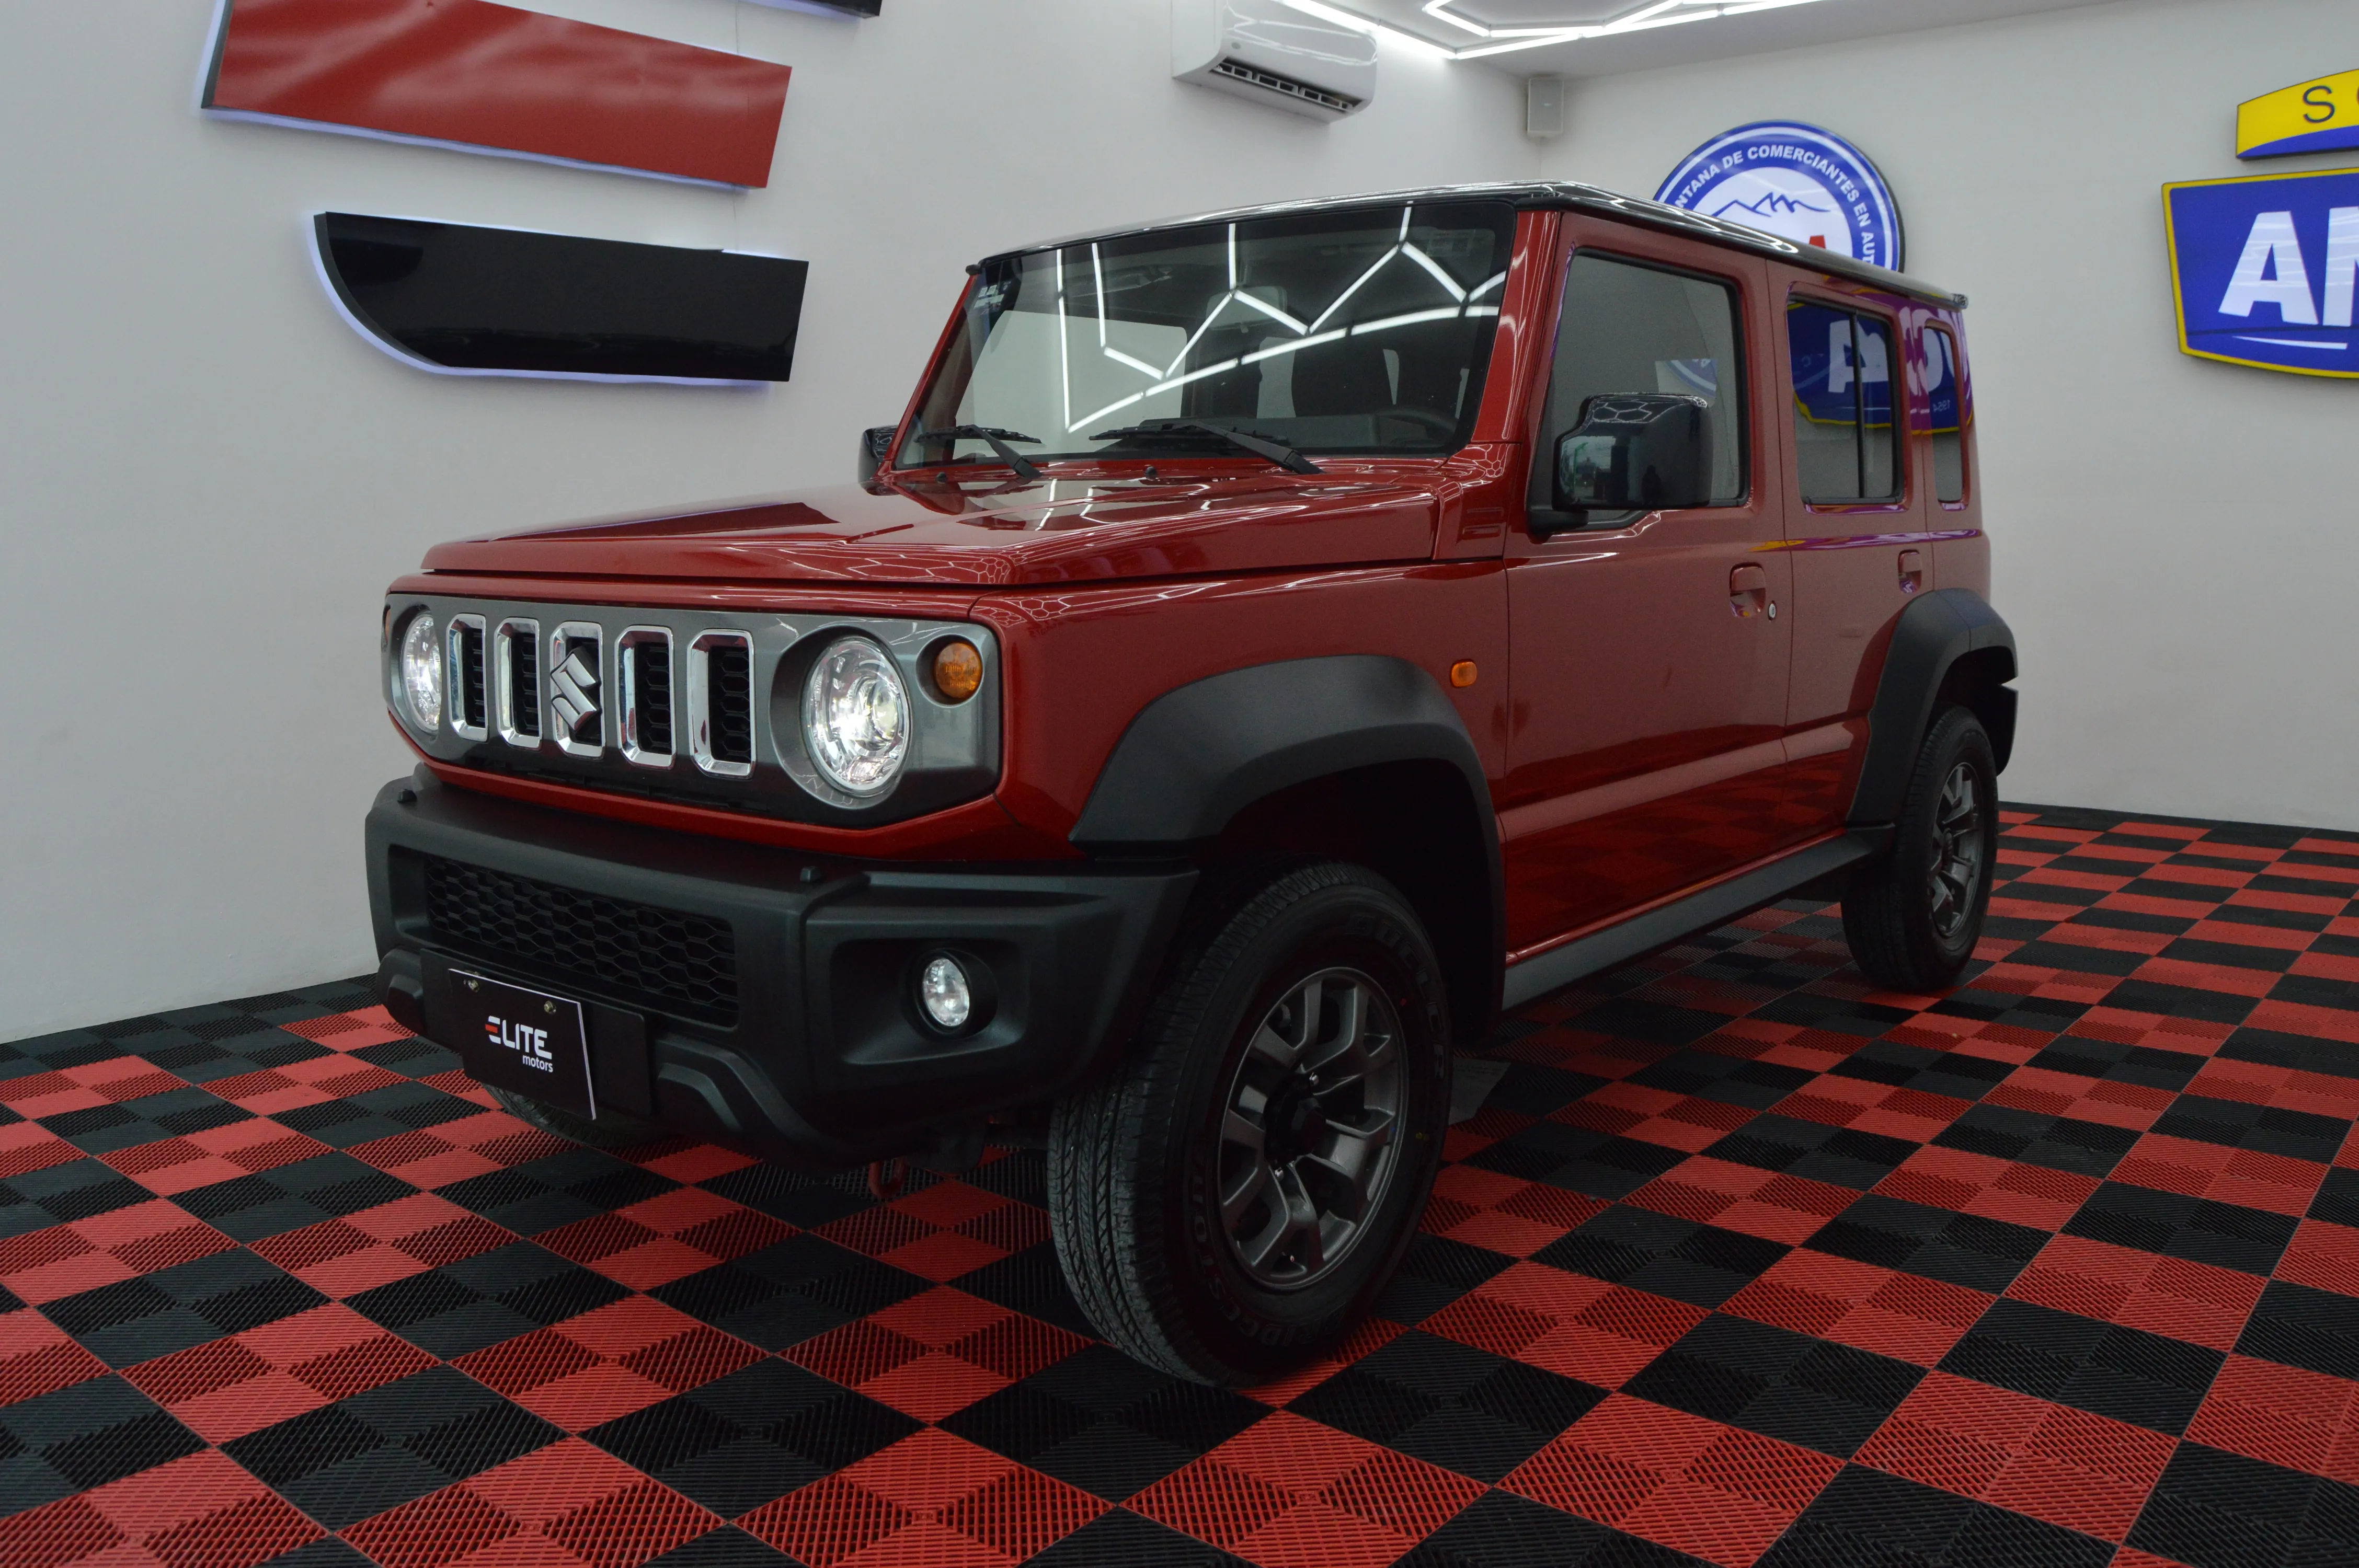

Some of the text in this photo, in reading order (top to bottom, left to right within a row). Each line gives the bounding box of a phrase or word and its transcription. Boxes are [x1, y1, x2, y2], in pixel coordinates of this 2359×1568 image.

[2303, 85, 2359, 124] S
[1722, 150, 1744, 169] DE
[1747, 144, 1860, 202] COMERCIANTES
[1853, 202, 1871, 227] EN
[485, 1015, 553, 1060] ELITE
[522, 1055, 554, 1073] motors
